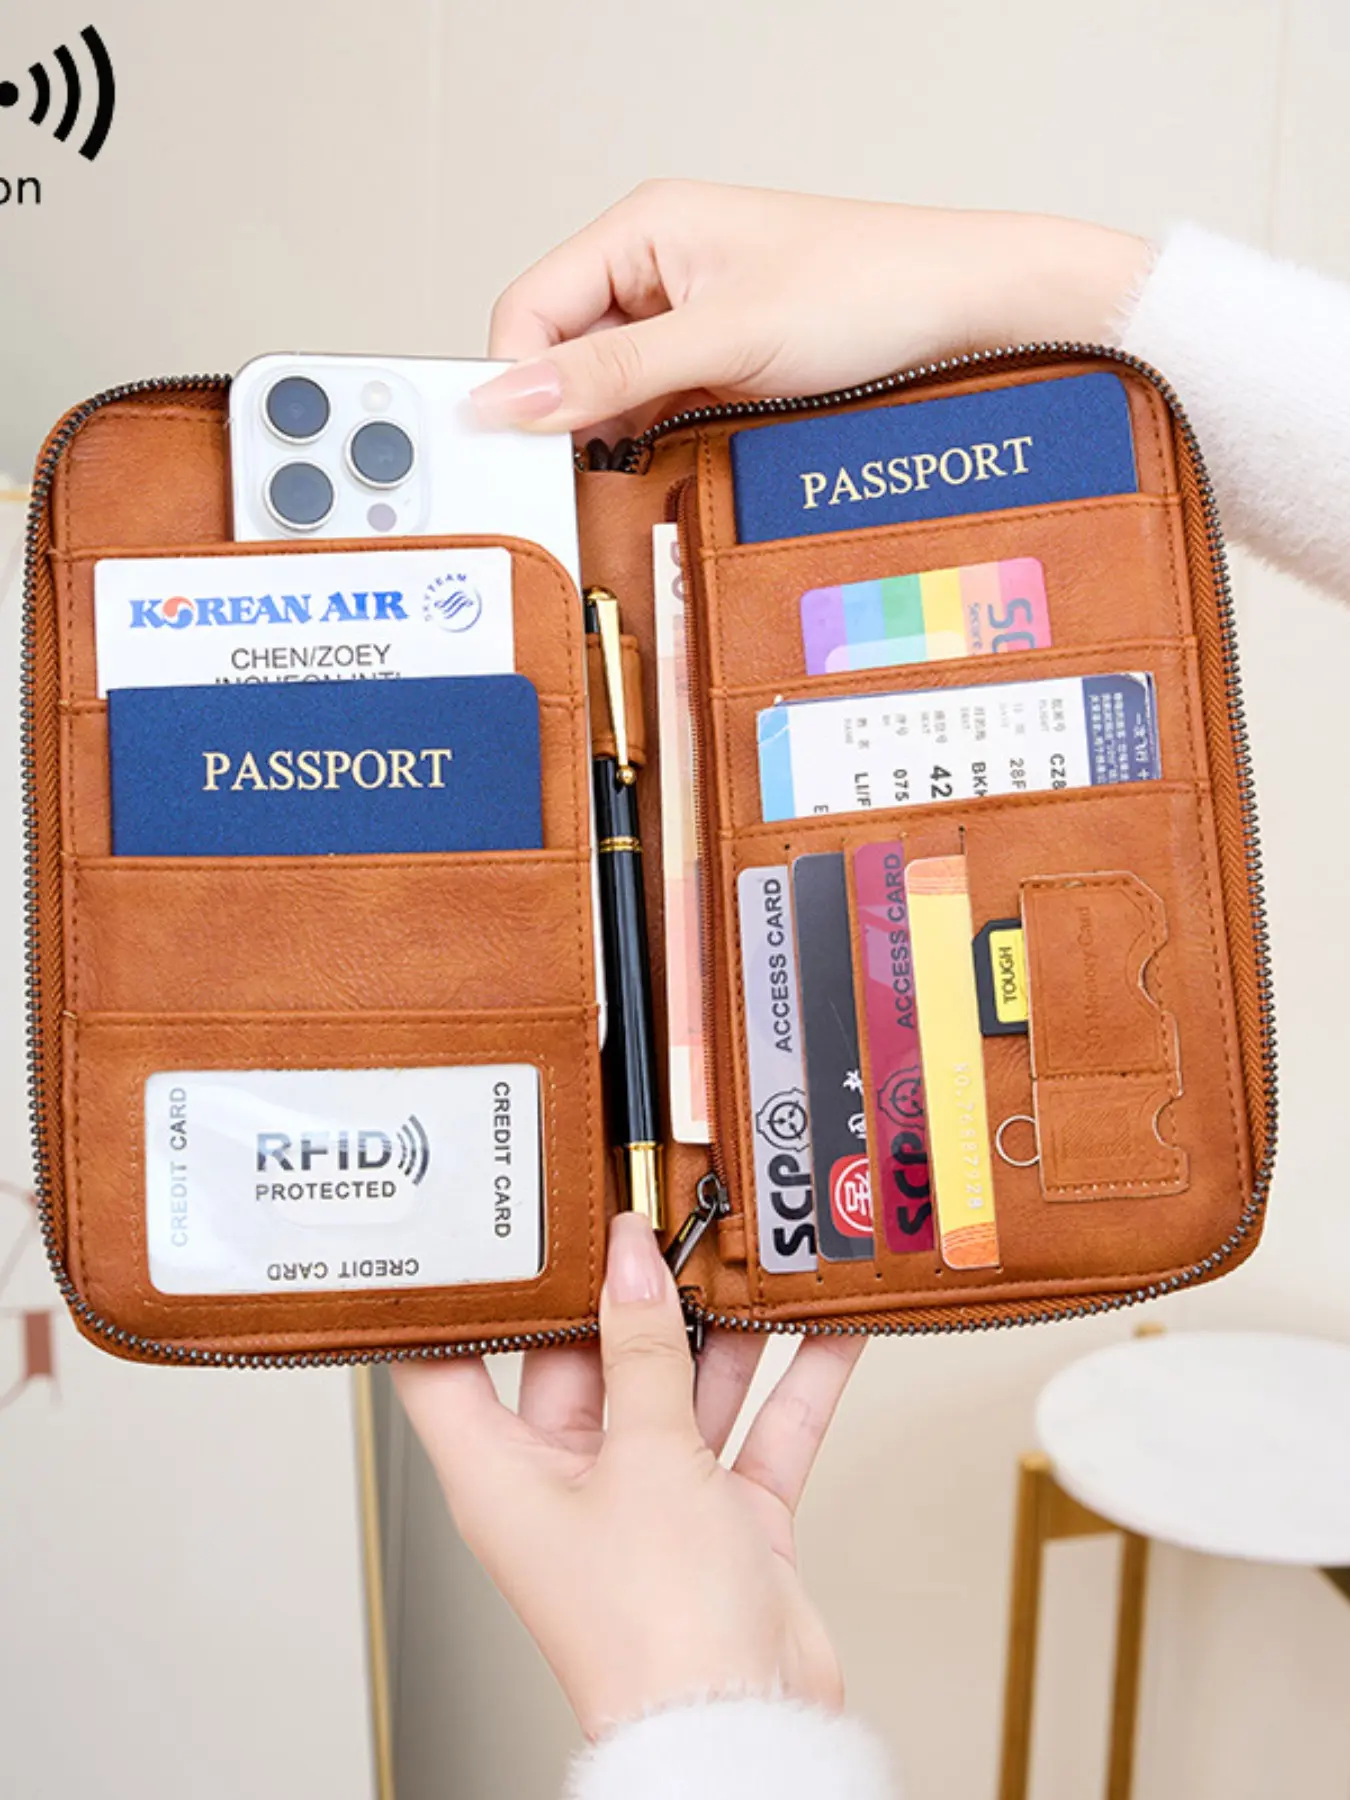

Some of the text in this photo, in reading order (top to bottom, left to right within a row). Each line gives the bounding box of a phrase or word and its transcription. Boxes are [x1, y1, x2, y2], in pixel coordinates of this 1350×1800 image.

[800, 436, 1033, 509] PASSPORT
[129, 590, 409, 630] KOREAN AIR
[231, 643, 392, 671] CHEN/ZOEY
[202, 749, 452, 791] PASSPORT
[892, 768, 910, 802] 075
[930, 765, 953, 799] 42
[1009, 757, 1027, 789] 28F
[883, 853, 915, 1030] ACCESS CARD
[763, 878, 793, 1054] ACCESS CARD
[998, 946, 1018, 1005] TOUGH
[169, 1087, 188, 1247] CREDIT CARD
[256, 1131, 393, 1173] RFID
[492, 1081, 512, 1238] CREDIT CARD
[255, 1180, 397, 1201] PROTECTED
[890, 1131, 932, 1235] SCP
[768, 1153, 817, 1256] SCP
[267, 1257, 420, 1281] CREDIT CARD
